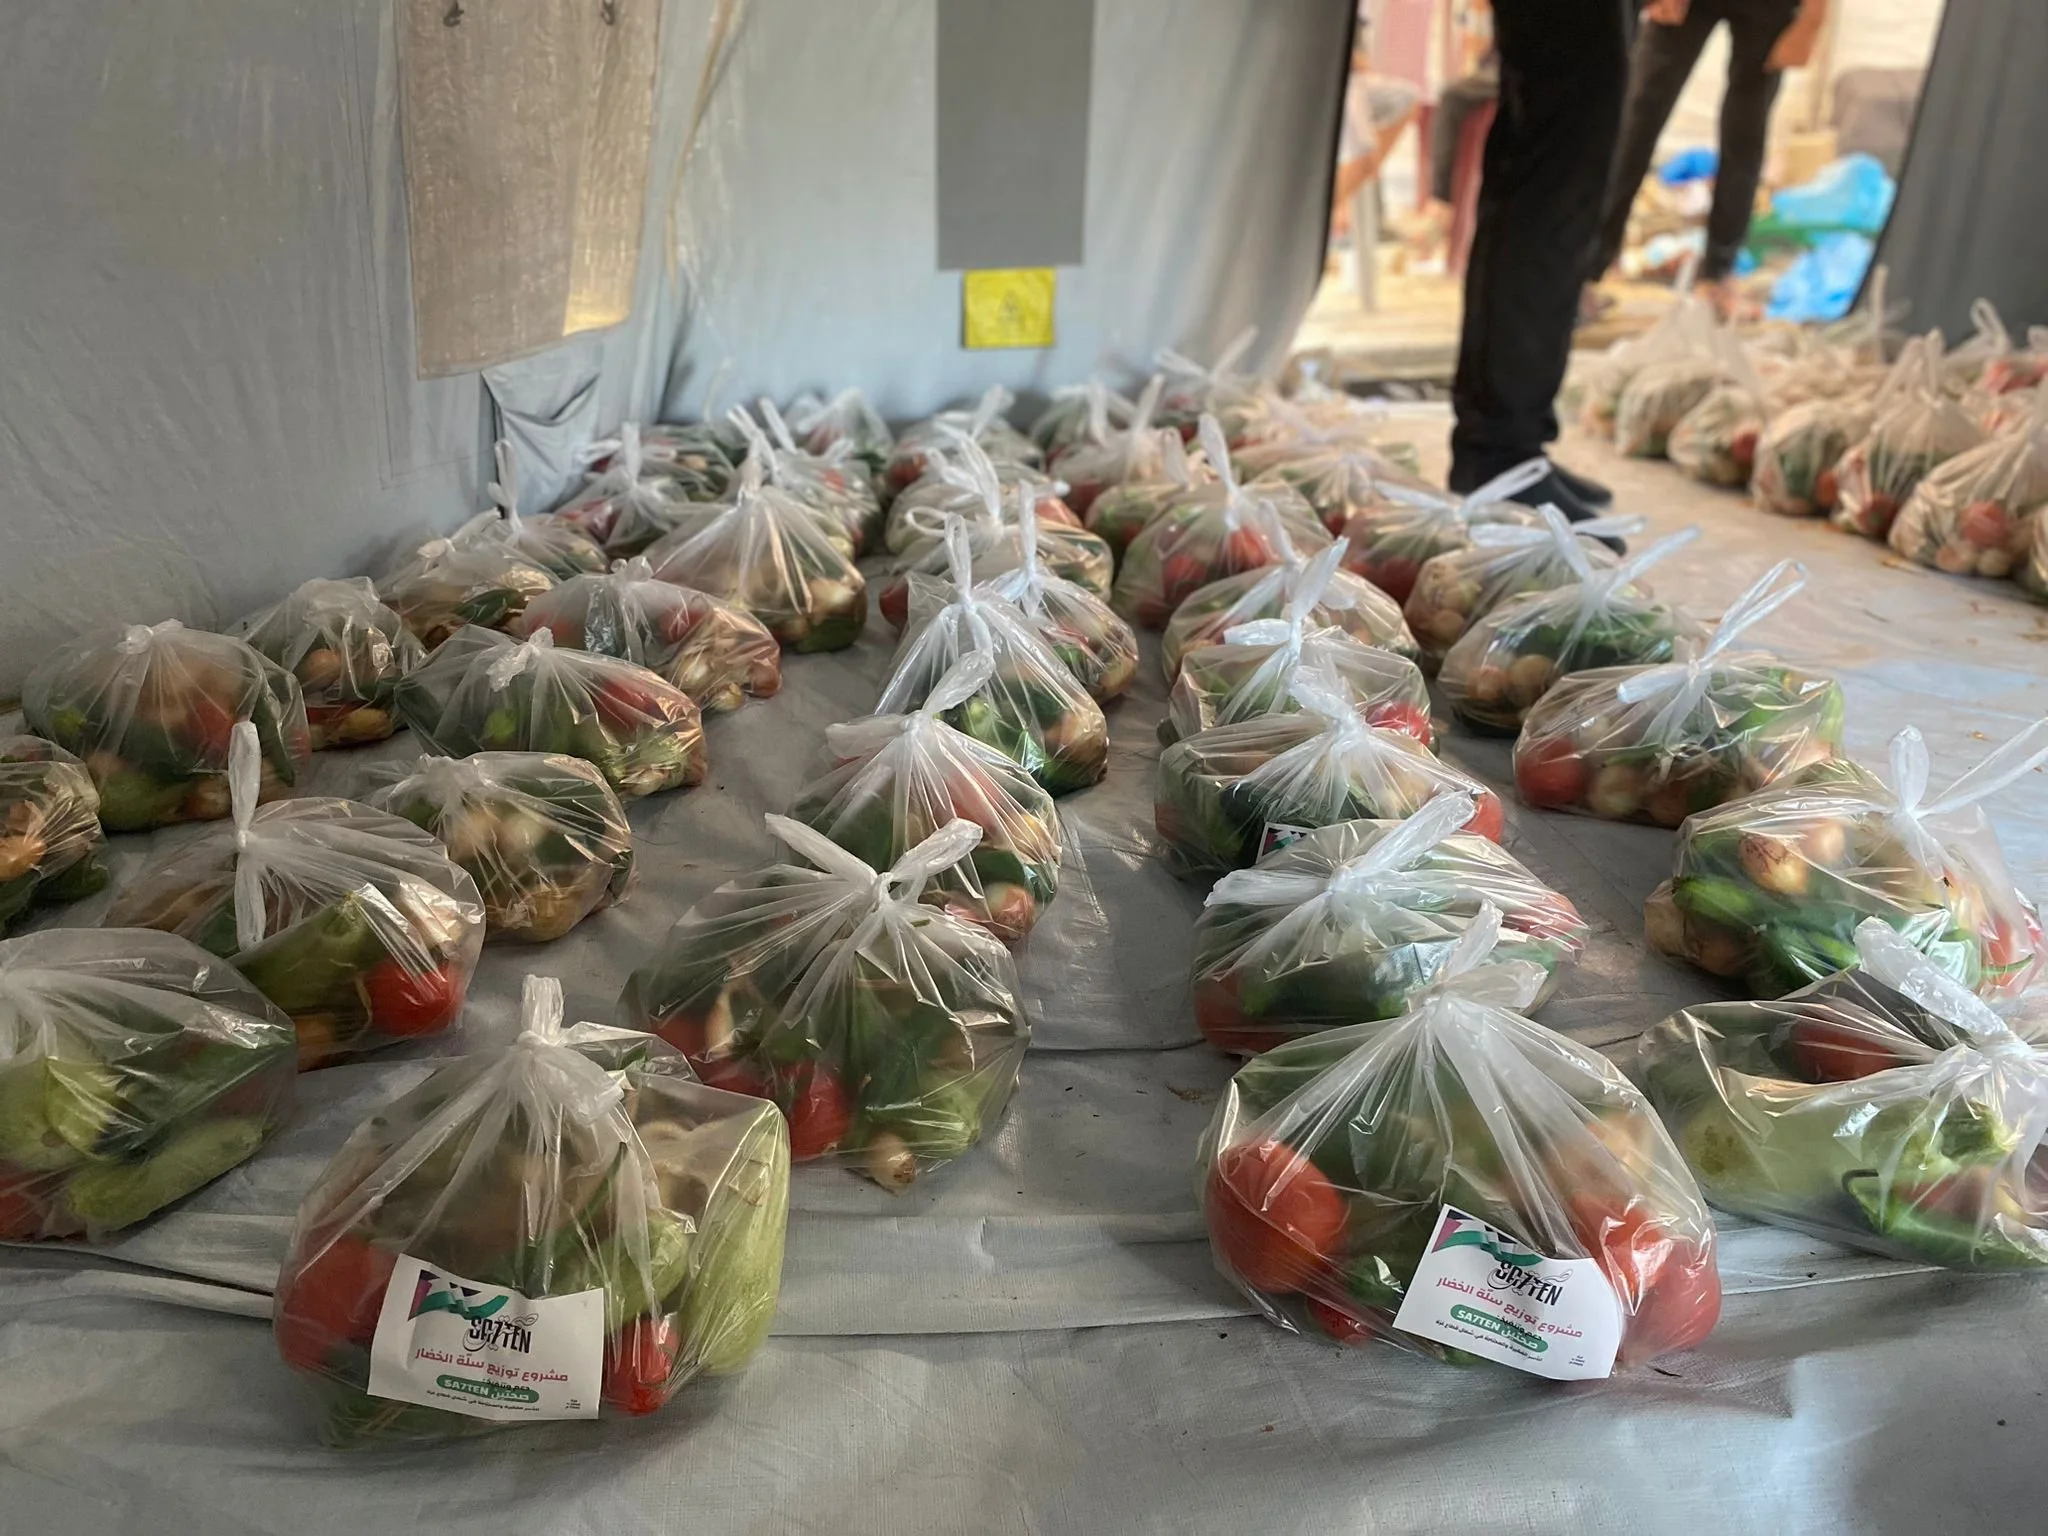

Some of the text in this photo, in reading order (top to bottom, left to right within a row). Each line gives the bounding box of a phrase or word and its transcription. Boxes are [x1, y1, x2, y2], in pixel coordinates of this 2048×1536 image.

[1436, 1277, 1474, 1294] الخضار
[1495, 1260, 1563, 1306] SA7TEN
[1457, 1310, 1500, 1331] SA7TEN
[1504, 1304, 1539, 1325] توزيع
[470, 1315, 531, 1353] SA7TEN
[1537, 1323, 1583, 1338] مشروع
[415, 1348, 453, 1363] الخضار
[487, 1363, 520, 1378] توزيع
[522, 1369, 568, 1382] مشروع
[444, 1380, 489, 1396] SA7TEN
